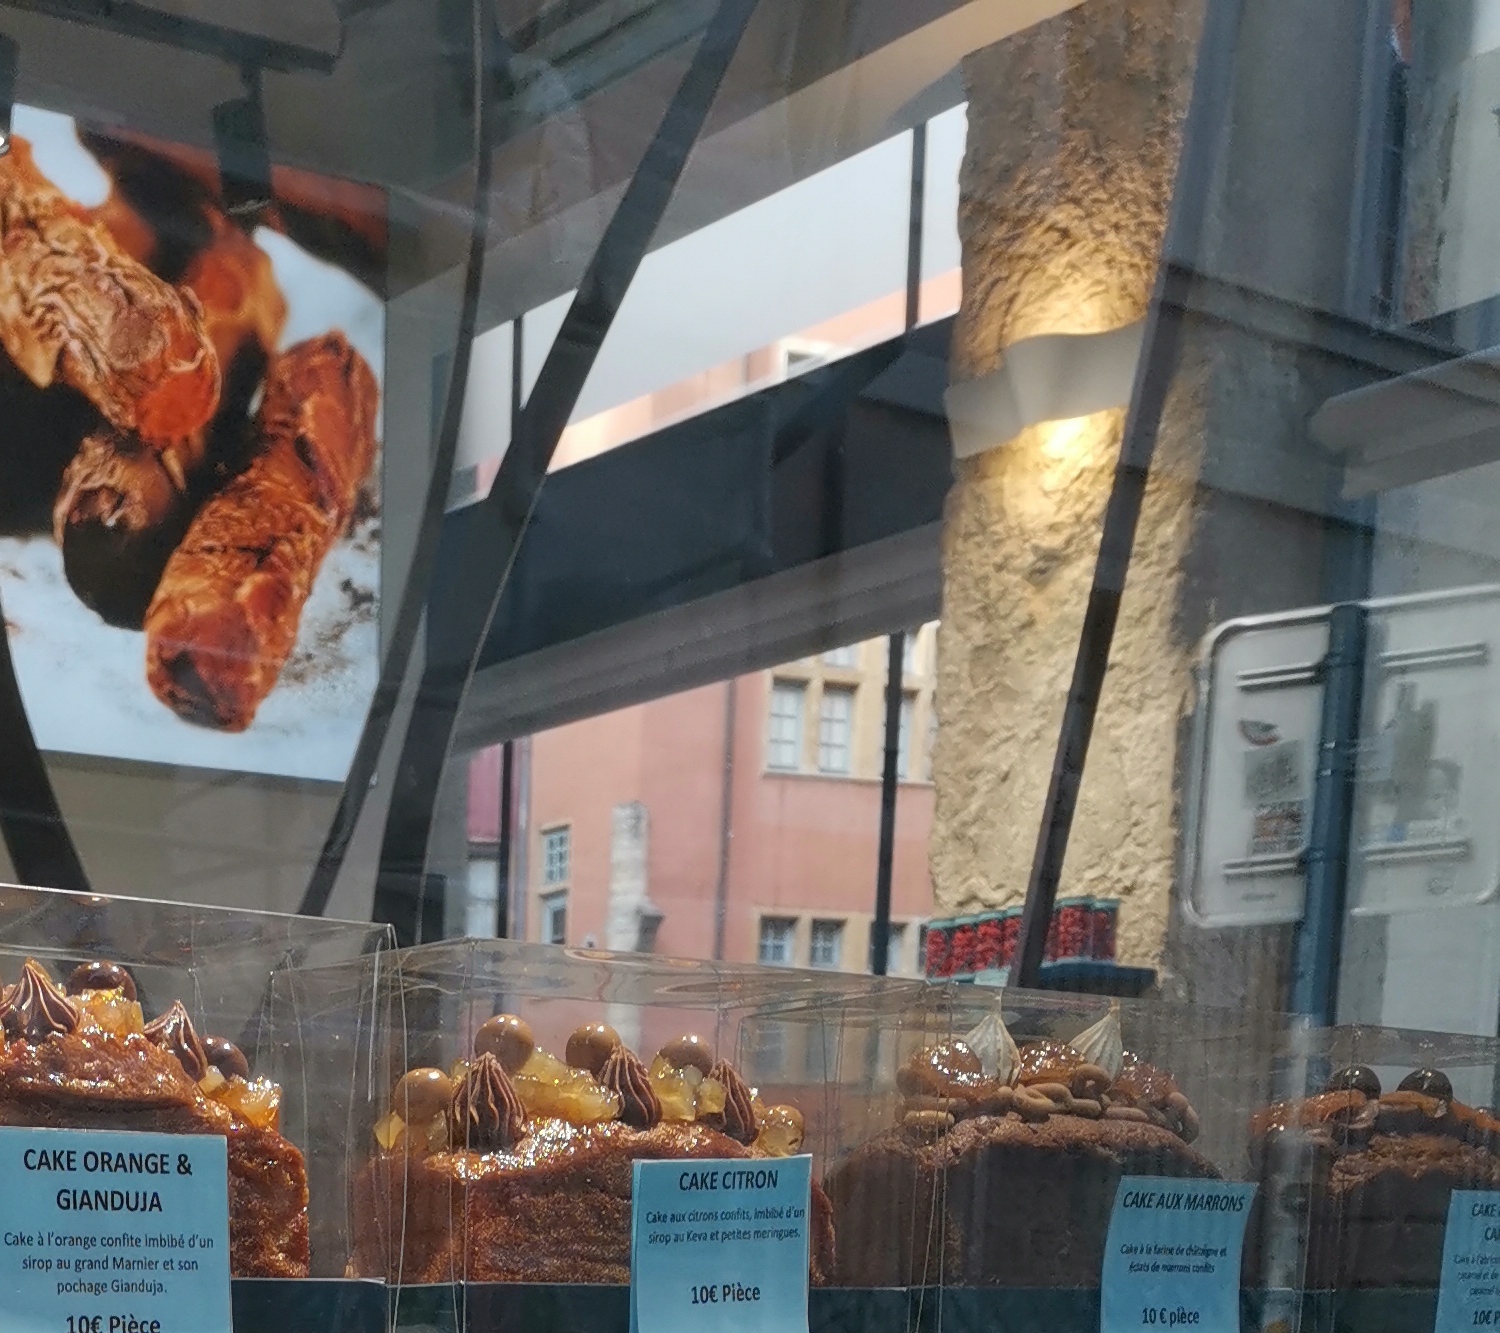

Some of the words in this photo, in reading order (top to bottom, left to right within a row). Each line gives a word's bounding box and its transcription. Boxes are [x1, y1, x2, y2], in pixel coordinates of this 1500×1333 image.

[23, 1148, 77, 1172] CAKE
[83, 1151, 170, 1175] ORANGE
[176, 1153, 193, 1176] &
[679, 1171, 719, 1191] CAKE
[722, 1169, 779, 1190] CITRON
[56, 1189, 163, 1212] GIANDUJA
[1122, 1191, 1156, 1210] CAKE
[1155, 1193, 1184, 1210] AUX
[1183, 1194, 1246, 1212] MARRONS
[645, 1211, 668, 1224] Cake
[669, 1213, 687, 1224] aux
[687, 1210, 719, 1223] citrons
[4, 1232, 34, 1247] Cake
[37, 1231, 45, 1247] à
[47, 1232, 97, 1251] l'orange
[100, 1233, 142, 1248] confite
[144, 1233, 185, 1249] imbibé
[188, 1234, 214, 1249] d'un
[22, 1254, 53, 1273] sirop
[56, 1258, 71, 1271] au
[74, 1256, 109, 1273] grand
[112, 1255, 158, 1271] Marnier
[162, 1258, 174, 1271] et
[177, 1259, 199, 1271] son
[57, 1279, 108, 1296] pochage
[110, 1279, 168, 1296] Gianduja.
[691, 1284, 719, 1305] 10€
[722, 1281, 761, 1303] Pièce
[1142, 1307, 1157, 1325] 10
[1159, 1307, 1167, 1325] €
[1169, 1305, 1200, 1327] pièce
